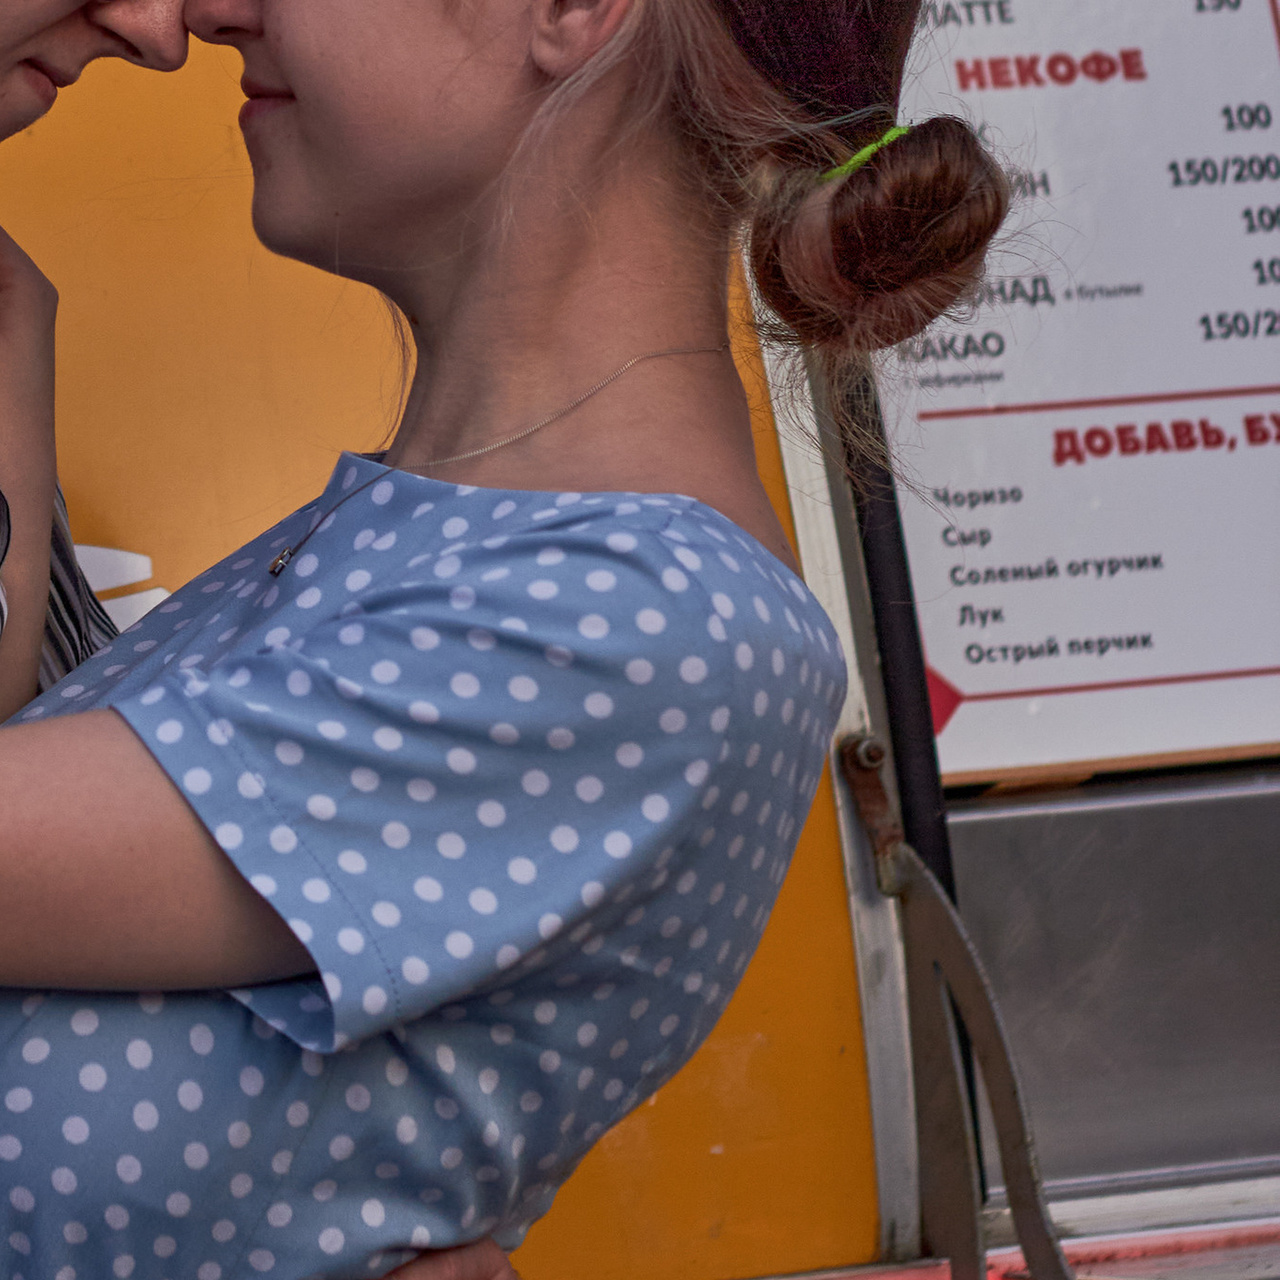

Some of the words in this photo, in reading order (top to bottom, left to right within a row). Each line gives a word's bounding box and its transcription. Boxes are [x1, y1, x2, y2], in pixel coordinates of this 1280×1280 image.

[954, 47, 1148, 92] НЕКОФЕ
[1221, 103, 1273, 132] 100
[1168, 153, 1280, 188] 150/200
[1242, 204, 1280, 234] 10
[1052, 418, 1238, 467] ДОБАВЬ,
[932, 487, 1024, 508] Чоризо
[941, 525, 993, 548] Сыр
[948, 558, 1060, 588] Соленый
[1066, 554, 1164, 579] огурчик
[958, 603, 1004, 628] Лук
[964, 636, 1061, 665] Острый
[1066, 633, 1154, 657] перчик
